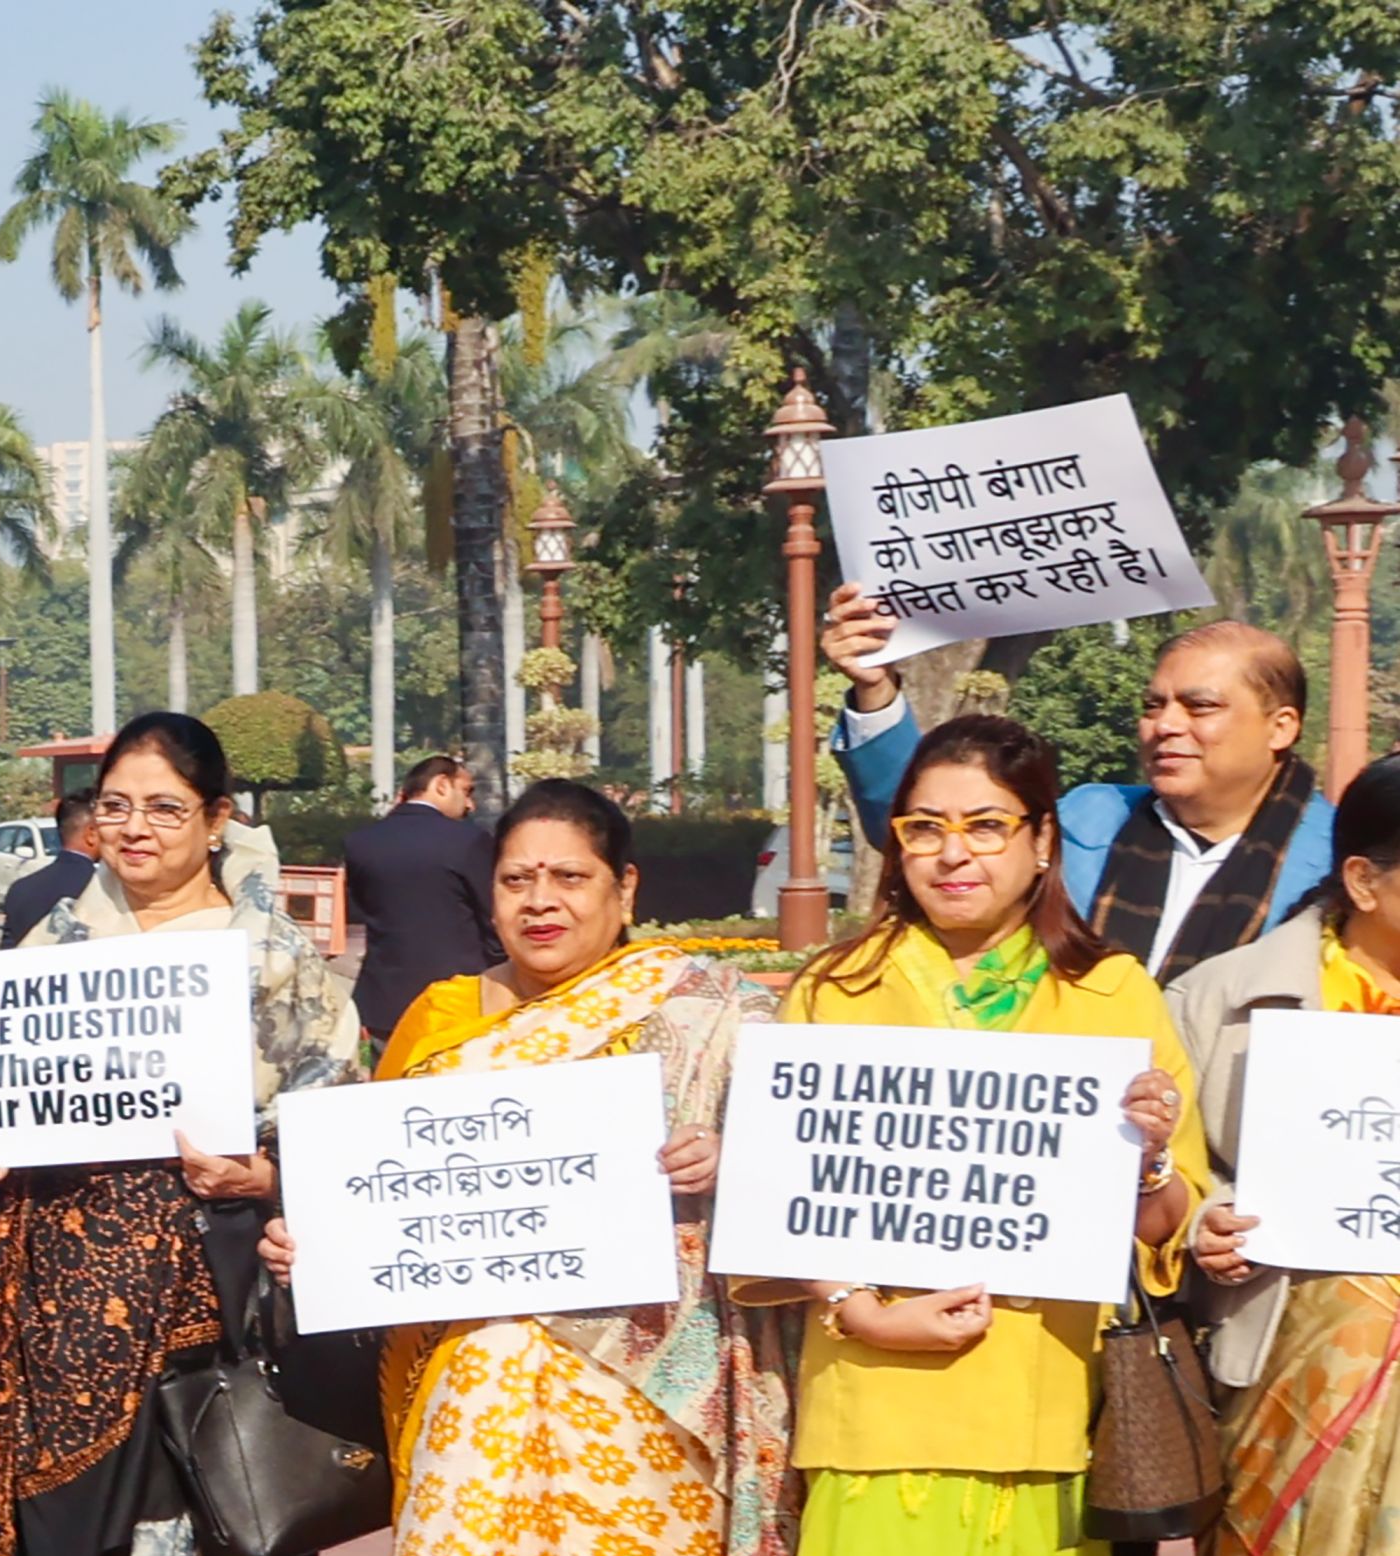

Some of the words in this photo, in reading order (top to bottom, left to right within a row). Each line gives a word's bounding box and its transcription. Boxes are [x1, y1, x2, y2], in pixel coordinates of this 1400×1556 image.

[871, 463, 977, 520] बीजेपी
[977, 453, 1087, 502] बंगाल
[868, 524, 921, 574] को
[921, 500, 1126, 563] जानबूझकर
[964, 568, 1039, 605] कर
[1035, 547, 1110, 595] रही
[79, 964, 208, 1003] VOICES
[22, 1005, 181, 1046] QUESTION
[103, 1046, 164, 1082] Are
[770, 1061, 822, 1102] 59
[832, 1063, 935, 1107] LAKH
[947, 1068, 1100, 1117] VOICES
[28, 1081, 183, 1127] Wages?
[402, 1097, 532, 1147] বিজেপি
[795, 1107, 864, 1146] ONE
[873, 1111, 1062, 1159] QUESTION
[811, 1153, 951, 1201] Where
[961, 1163, 1036, 1207] Are
[400, 1205, 548, 1244] বাংলাকে
[786, 1195, 859, 1239] Our
[871, 1201, 1050, 1253] Wages?
[370, 1248, 474, 1292] বঞ্চিত
[482, 1247, 585, 1283] করছে
